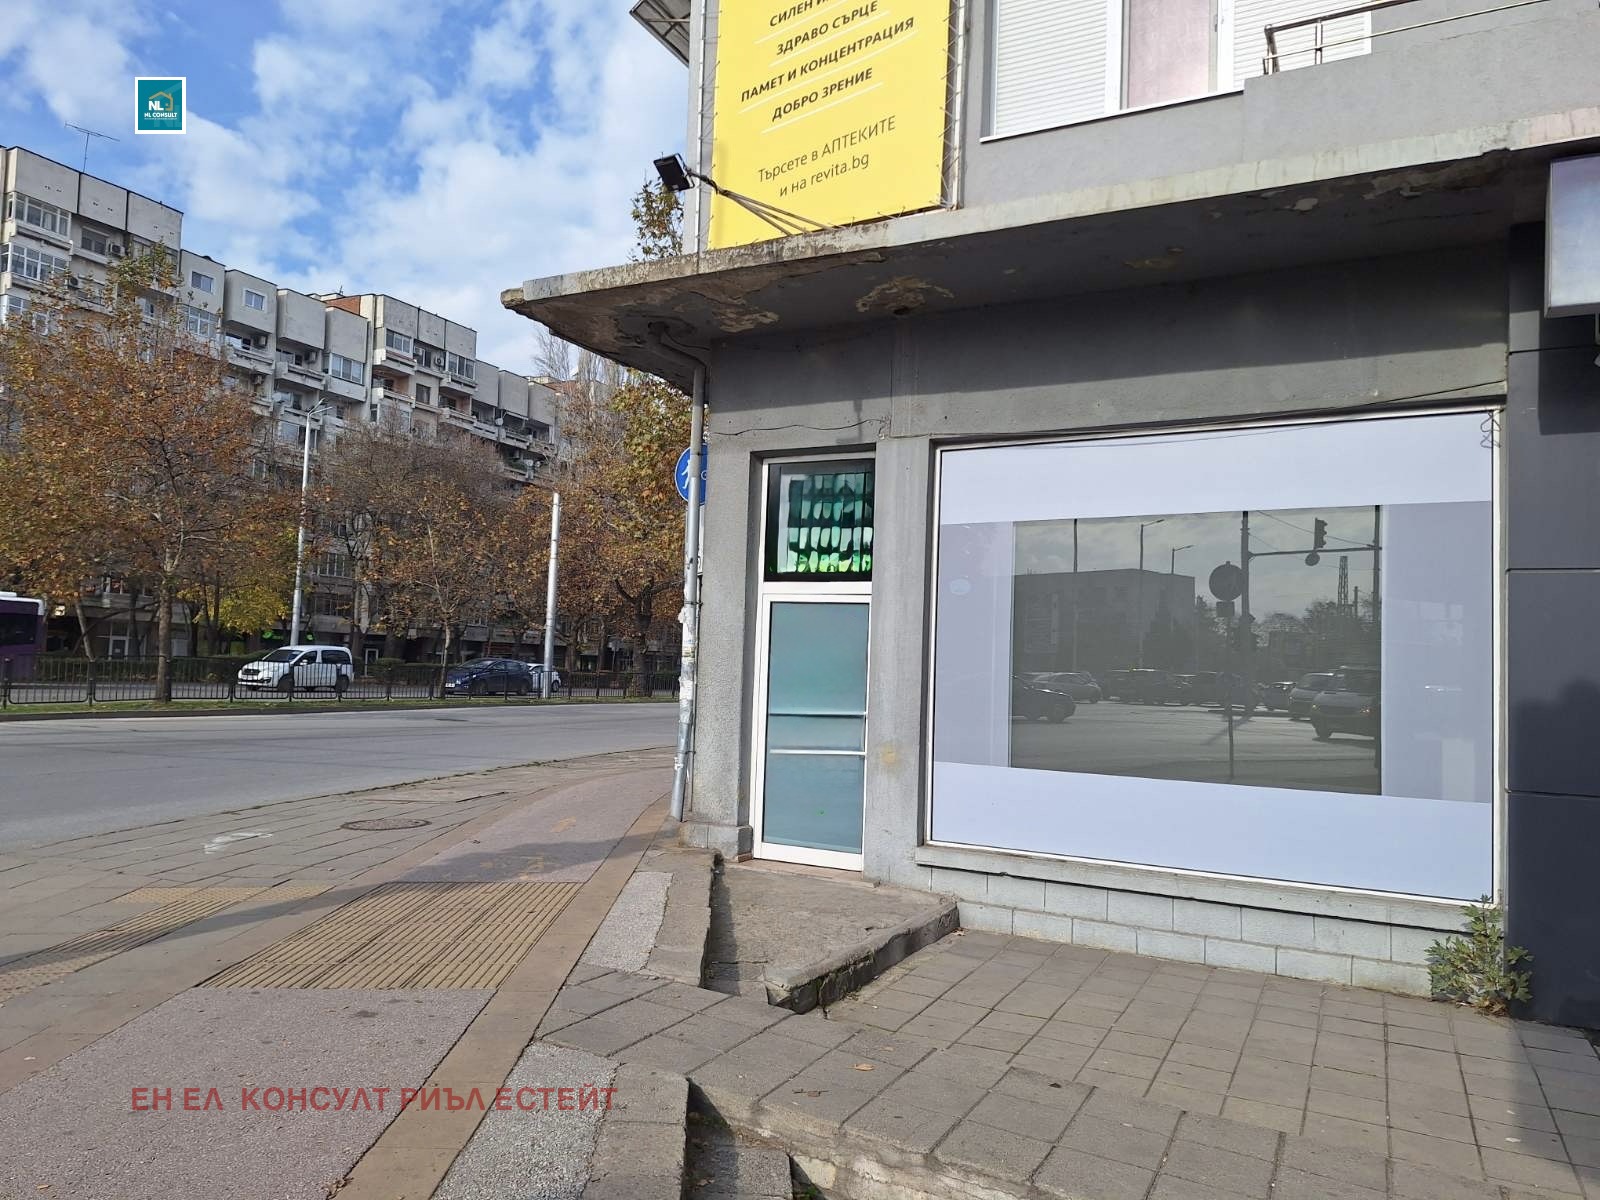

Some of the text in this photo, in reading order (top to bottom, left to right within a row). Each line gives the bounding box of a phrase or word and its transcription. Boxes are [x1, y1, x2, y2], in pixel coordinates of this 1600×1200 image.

[770, 0, 812, 27] СИЛЕН
[776, 0, 878, 55] ЗДРАВО СЪРЦЕ
[741, 17, 915, 102] ПАМЕТ И КОНЦЕНТРАЦИЯ
[772, 67, 873, 122] ДОБРО ЗРЕНИЕ
[758, 115, 896, 182] Търсете в АПТЕКИТЕ
[780, 154, 869, 198] и на revita.bg
